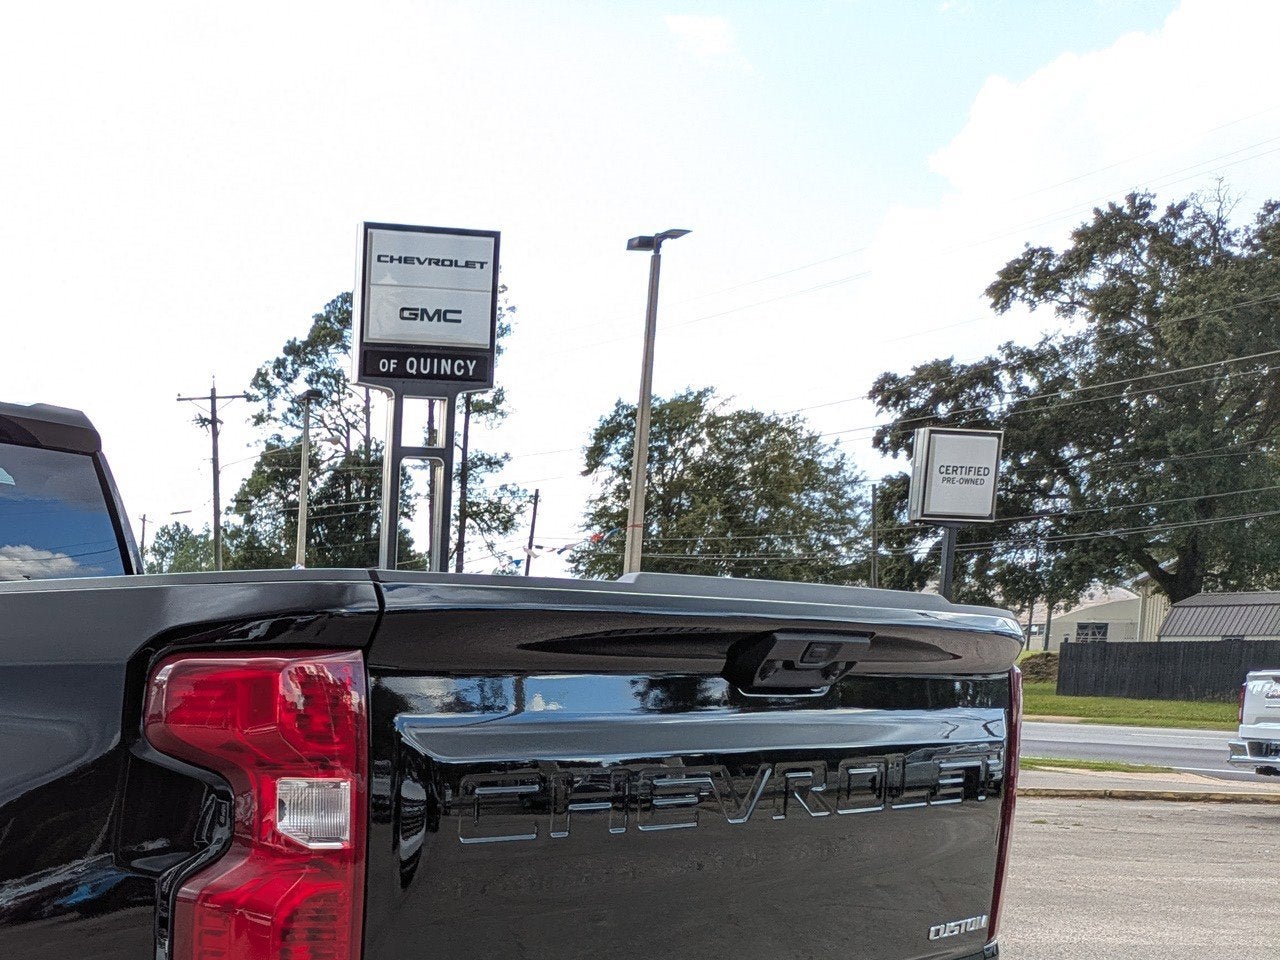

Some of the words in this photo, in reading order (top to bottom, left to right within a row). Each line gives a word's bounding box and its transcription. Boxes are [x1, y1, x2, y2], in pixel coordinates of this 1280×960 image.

[376, 254, 488, 270] CHEVROLET
[399, 306, 462, 324] GMC
[379, 358, 398, 373] OF
[405, 357, 477, 376] QUINCY
[938, 465, 990, 477] CERTIFIED
[941, 476, 985, 486] PRE-OWNED
[458, 755, 995, 843] CHEVROLET
[929, 914, 988, 940] CUSTOM
